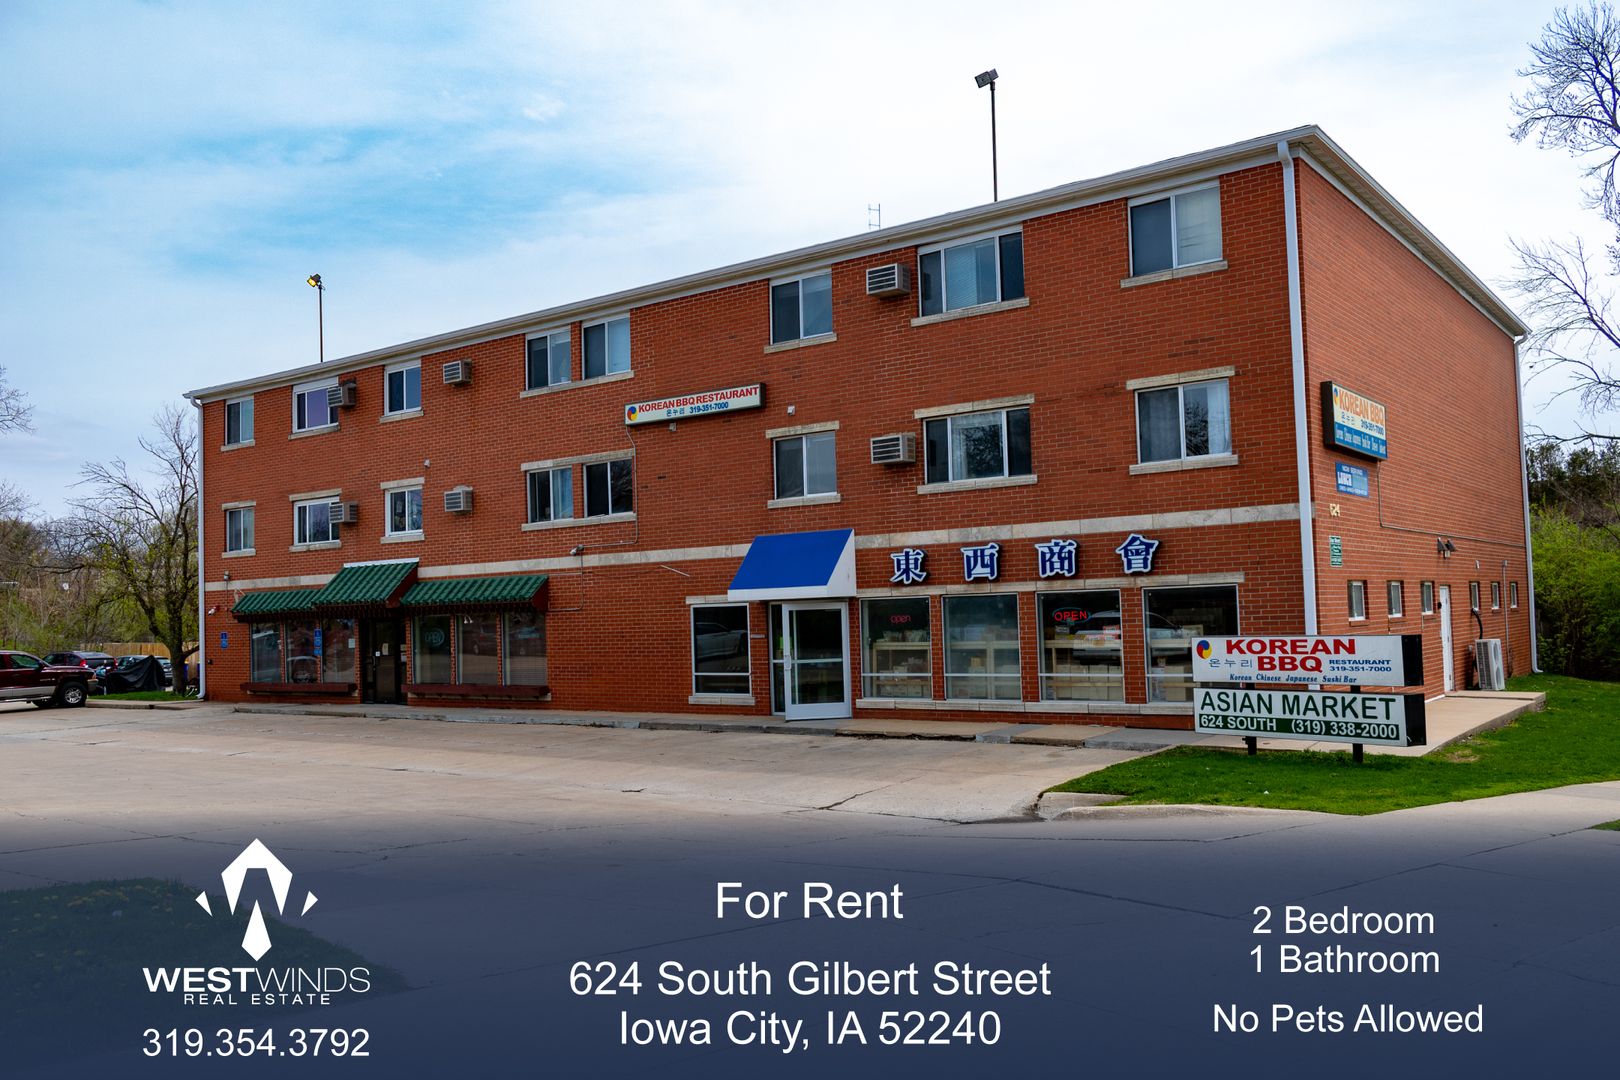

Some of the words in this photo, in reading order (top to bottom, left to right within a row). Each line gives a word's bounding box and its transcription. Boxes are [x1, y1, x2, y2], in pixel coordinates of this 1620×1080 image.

[639, 399, 675, 413] KOREAN
[676, 396, 695, 407] BBQ
[695, 387, 759, 404] RESTAURANT
[689, 402, 729, 414] 319-351-7000
[1340, 389, 1369, 420] KOREAN
[890, 533, 1159, 585] 東西商會
[890, 614, 911, 624] open
[1054, 610, 1088, 622] OPEN
[1225, 639, 1356, 655] KOREAN
[1208, 658, 1253, 668] 온누리
[1257, 656, 1323, 673] BBQ
[1229, 673, 1252, 681] Korean
[1256, 673, 1281, 682] Chinese
[1285, 674, 1317, 683] Japanese
[1343, 675, 1357, 683] Bar
[1200, 691, 1273, 715] ASIAN
[1282, 695, 1397, 721] MARKET
[1201, 714, 1223, 728] 624
[1227, 716, 1277, 731] SOUTH
[1291, 718, 1326, 736] (319)
[1330, 721, 1397, 739] 338-2000
